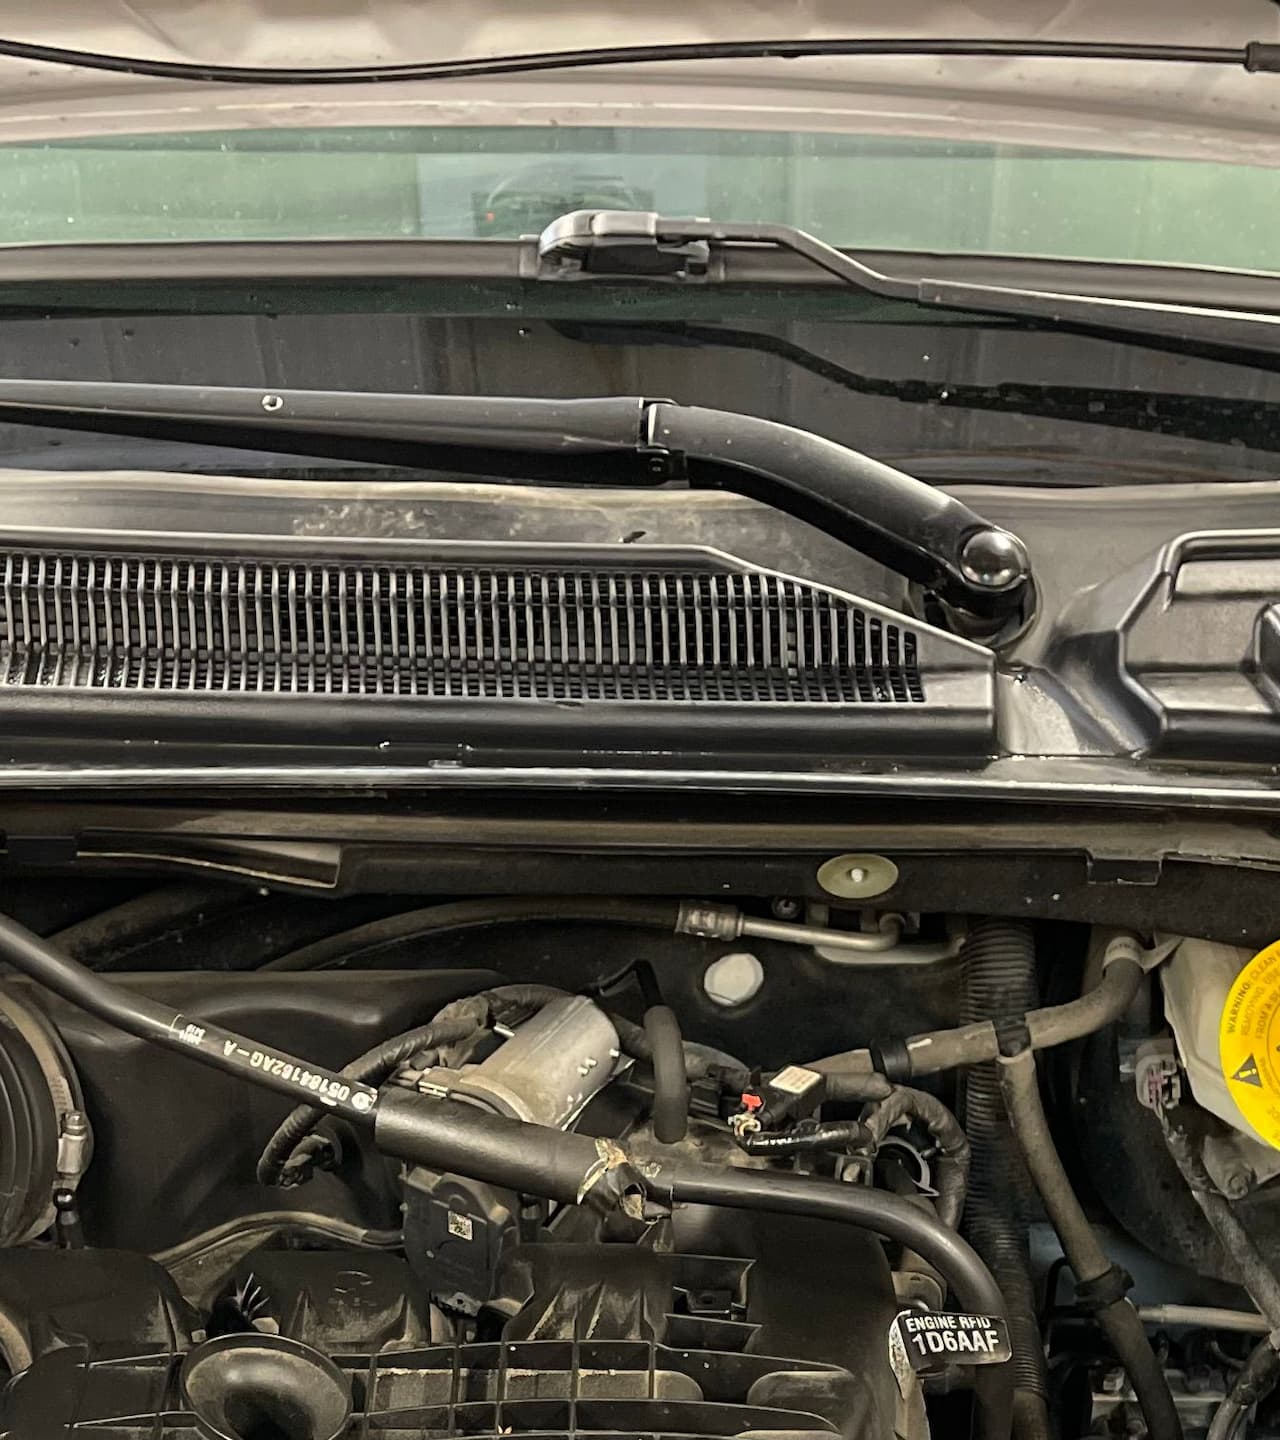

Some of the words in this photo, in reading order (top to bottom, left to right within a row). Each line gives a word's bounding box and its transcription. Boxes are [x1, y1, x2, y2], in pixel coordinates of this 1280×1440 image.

[1250, 956, 1276, 979] CLEAN
[904, 1316, 957, 1333] ENGINE
[959, 1316, 991, 1329] RFID
[911, 1330, 1000, 1356] 1D6AAF
